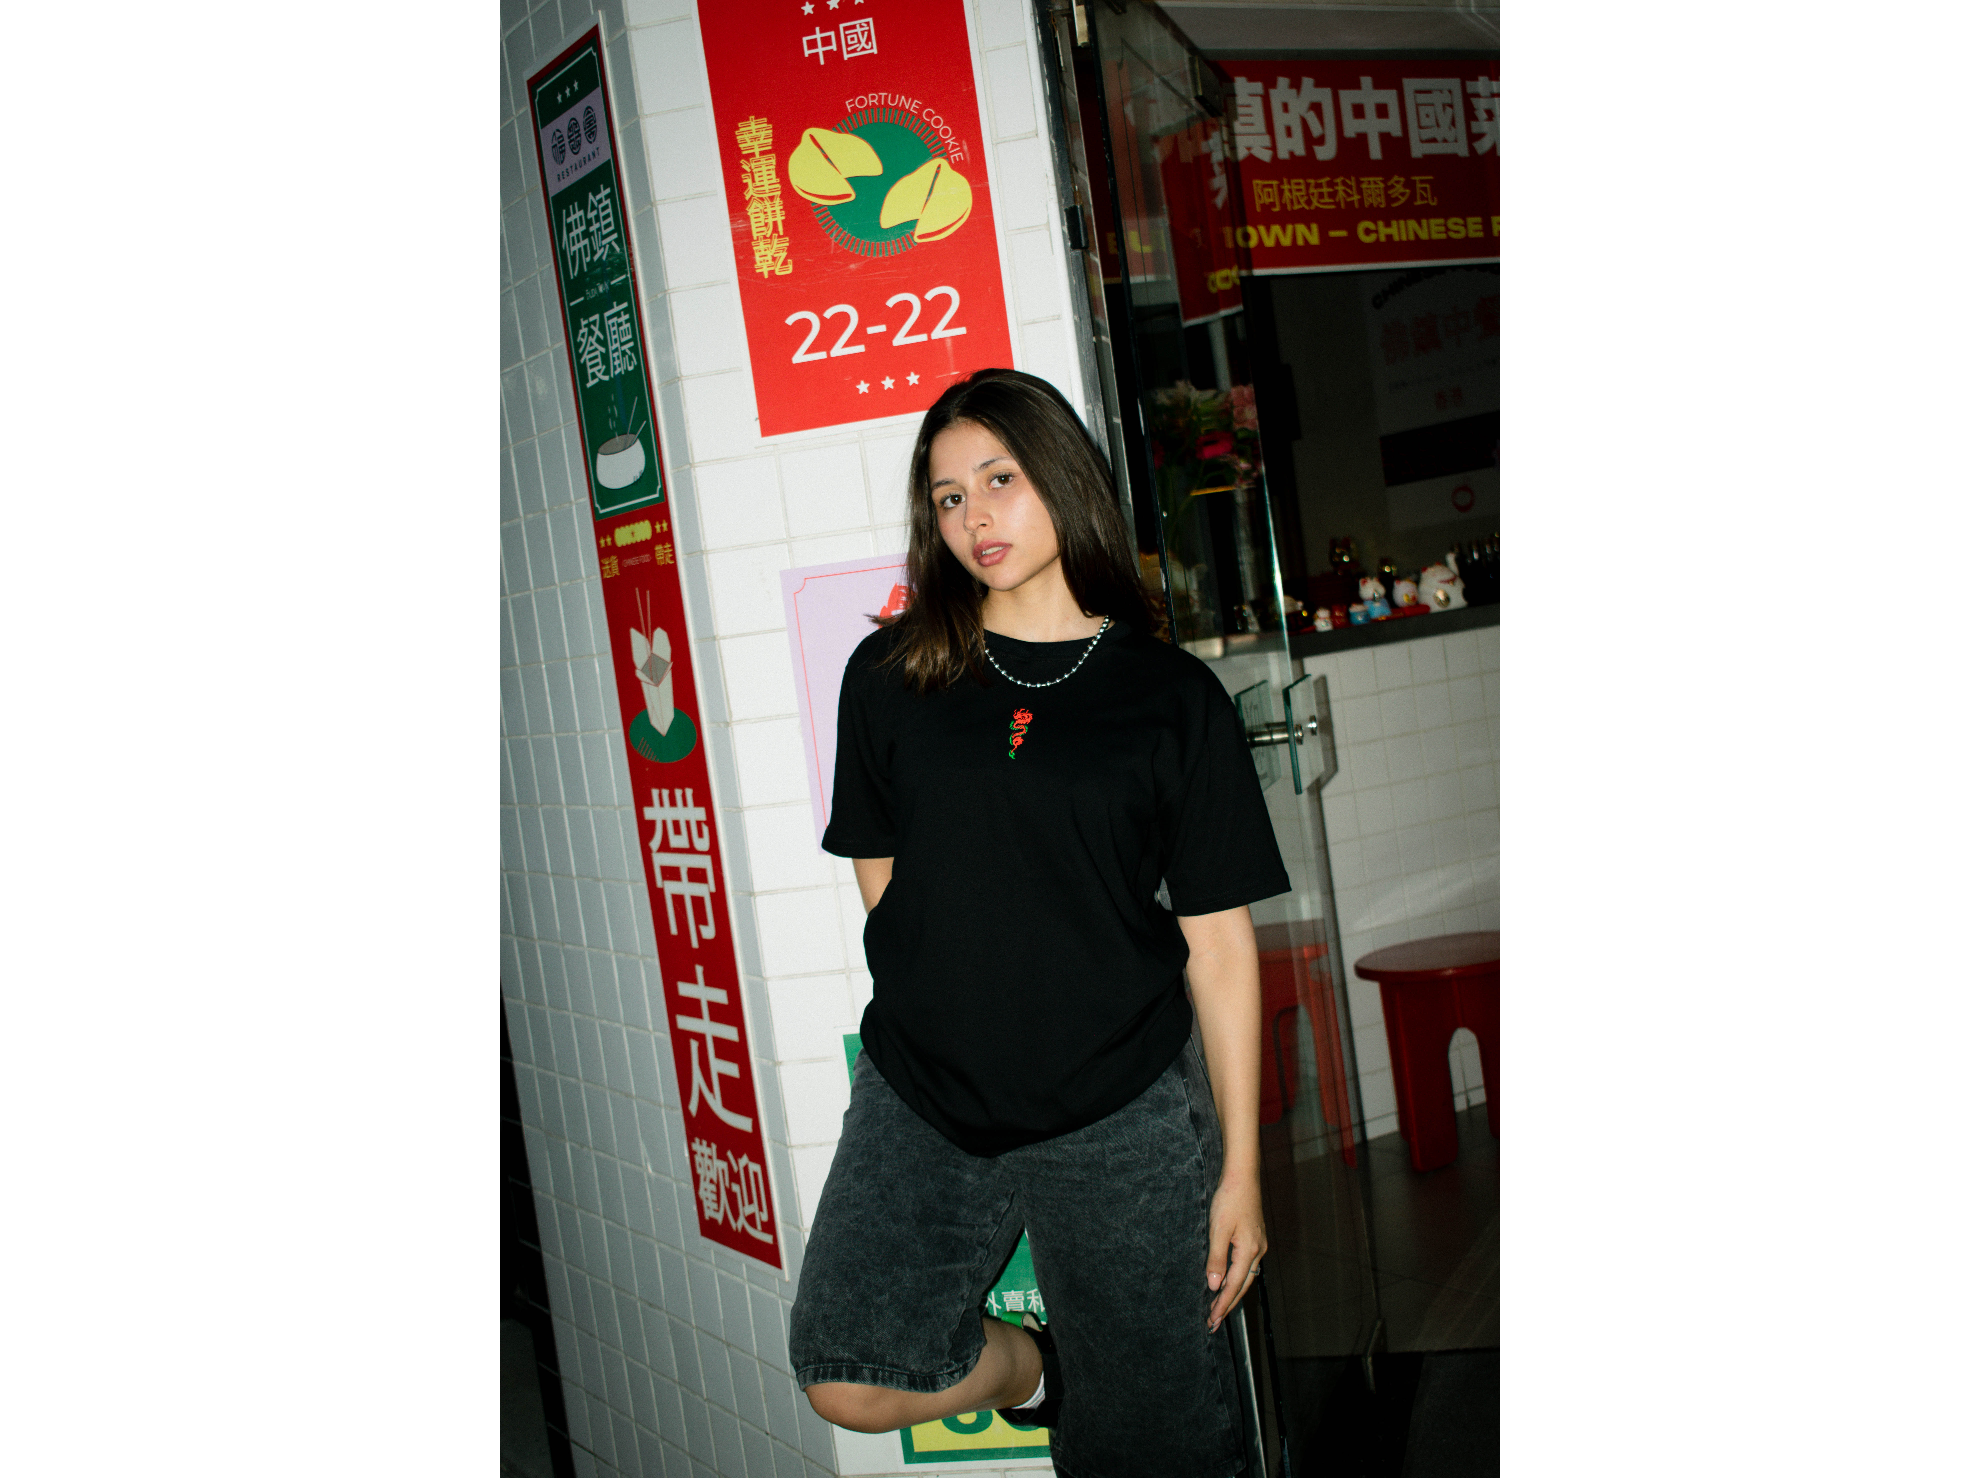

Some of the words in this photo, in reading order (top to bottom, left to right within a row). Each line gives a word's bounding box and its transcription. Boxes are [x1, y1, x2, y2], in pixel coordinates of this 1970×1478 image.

[802, 17, 878, 65] 中國
[557, 147, 600, 182] RESTAURANT
[845, 92, 922, 113] FORTUNE
[922, 108, 964, 164] COOKIE
[562, 183, 621, 280] 佛鎮
[735, 115, 793, 279] 幸運餅乾
[1252, 175, 1438, 213] 阿根廷科爾多瓦
[1356, 216, 1485, 244] CHINESE
[577, 301, 638, 389] 餐廳
[784, 285, 967, 364] 22-22
[643, 787, 754, 1133] 帶走
[691, 1137, 773, 1245] 歡迎
